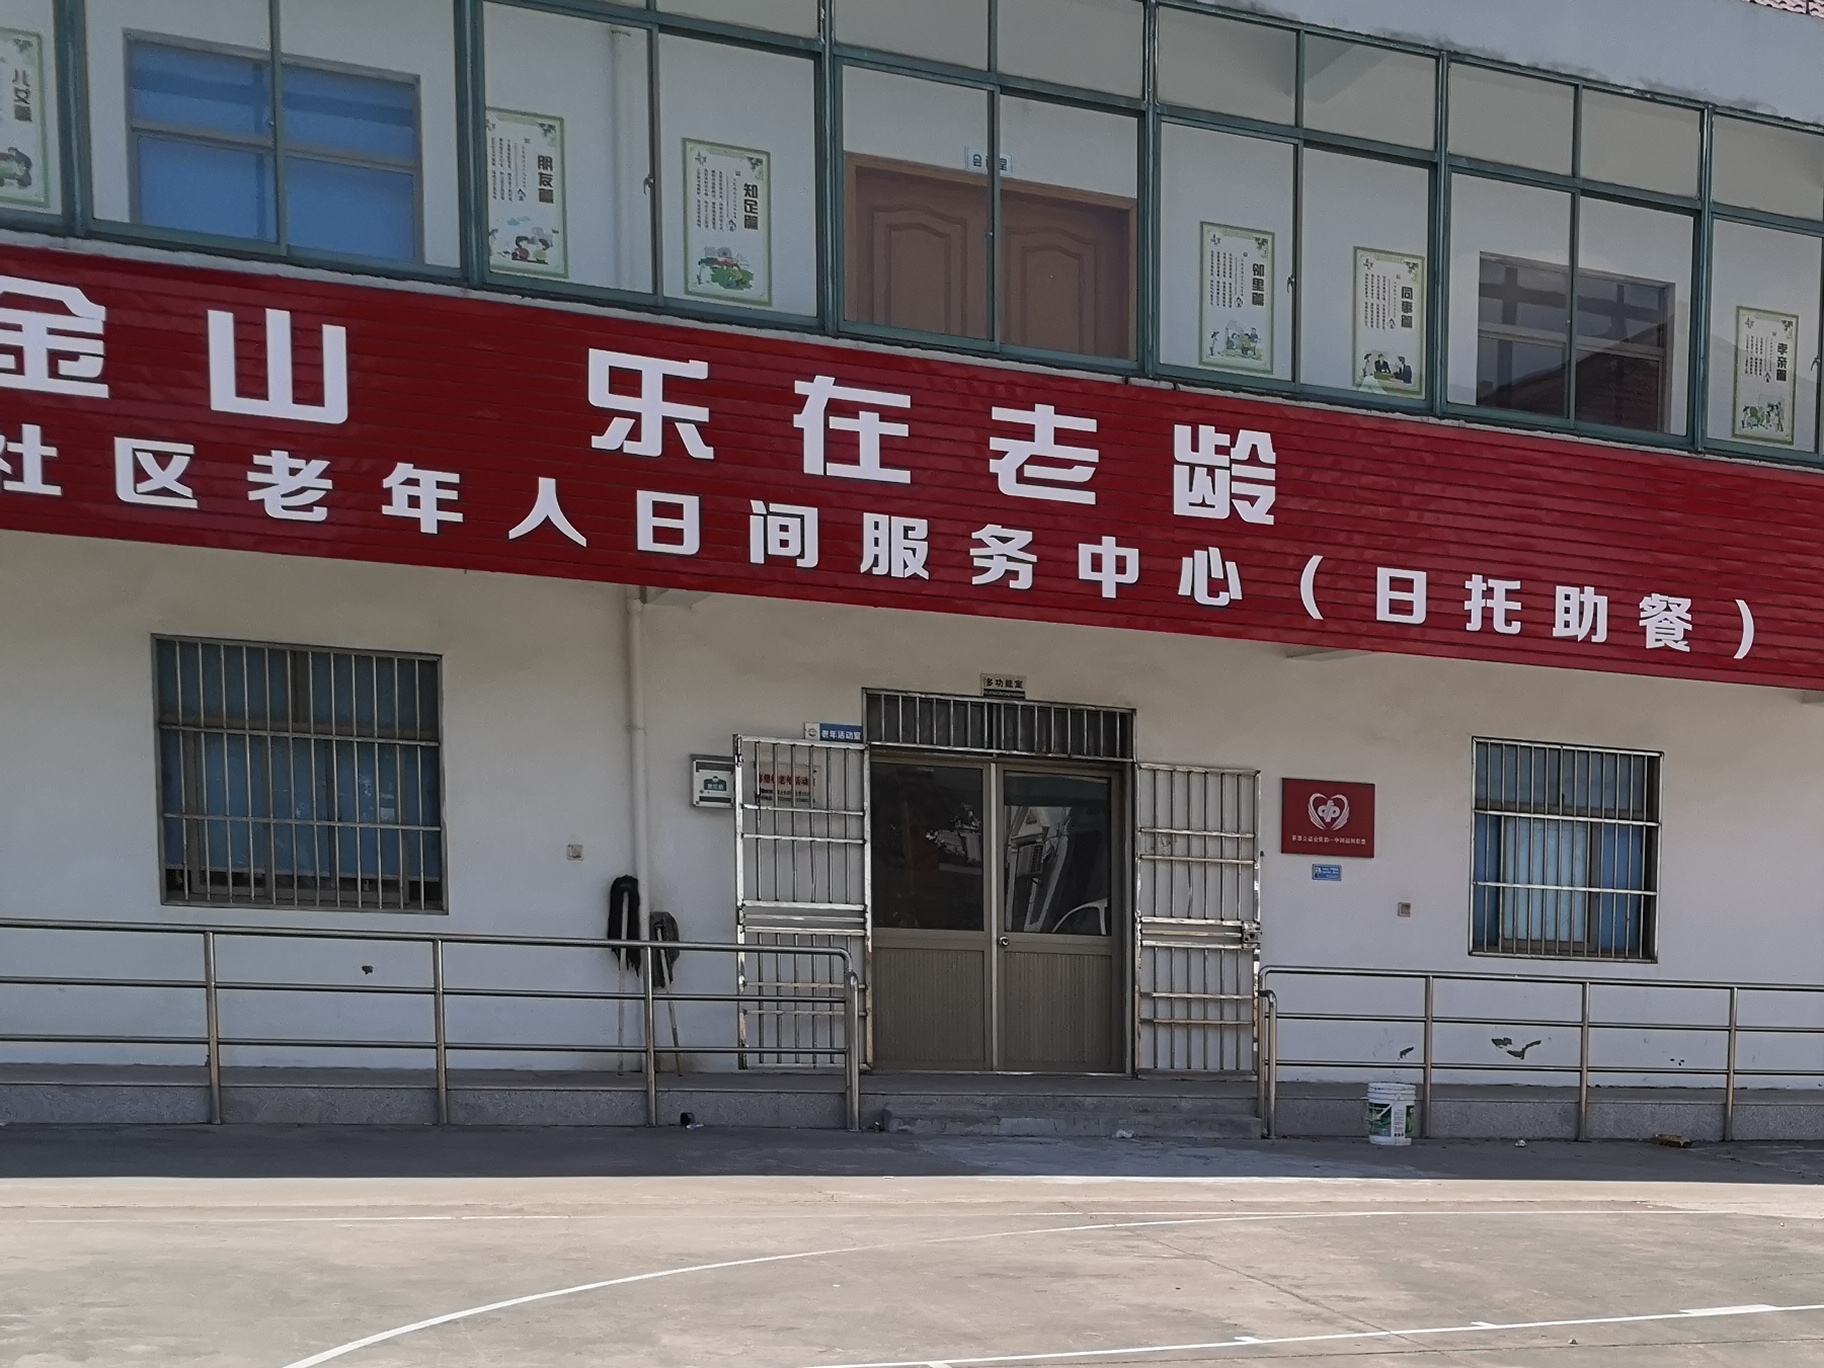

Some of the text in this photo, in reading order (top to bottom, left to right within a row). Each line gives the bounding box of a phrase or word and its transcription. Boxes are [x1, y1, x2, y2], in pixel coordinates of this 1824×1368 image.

[537, 154, 554, 204] 朋友篇
[972, 153, 1008, 171] 会室
[743, 182, 759, 230] 知足篇
[588, 348, 1277, 525] 乐在老龄
[821, 729, 861, 740] 老年活动室
